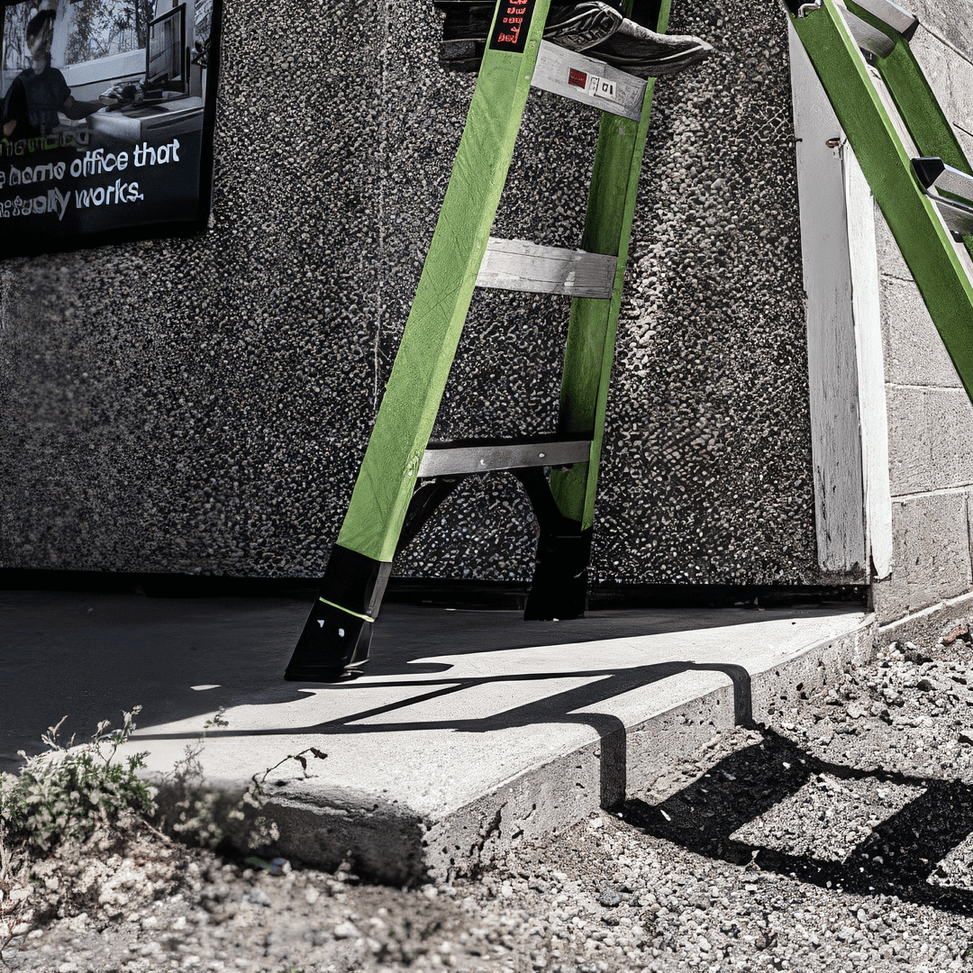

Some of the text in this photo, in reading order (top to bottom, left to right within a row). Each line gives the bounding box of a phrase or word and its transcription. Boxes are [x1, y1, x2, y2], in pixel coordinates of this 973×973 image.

[70, 147, 129, 178] office
[133, 138, 181, 168] that
[75, 178, 144, 209] works.
